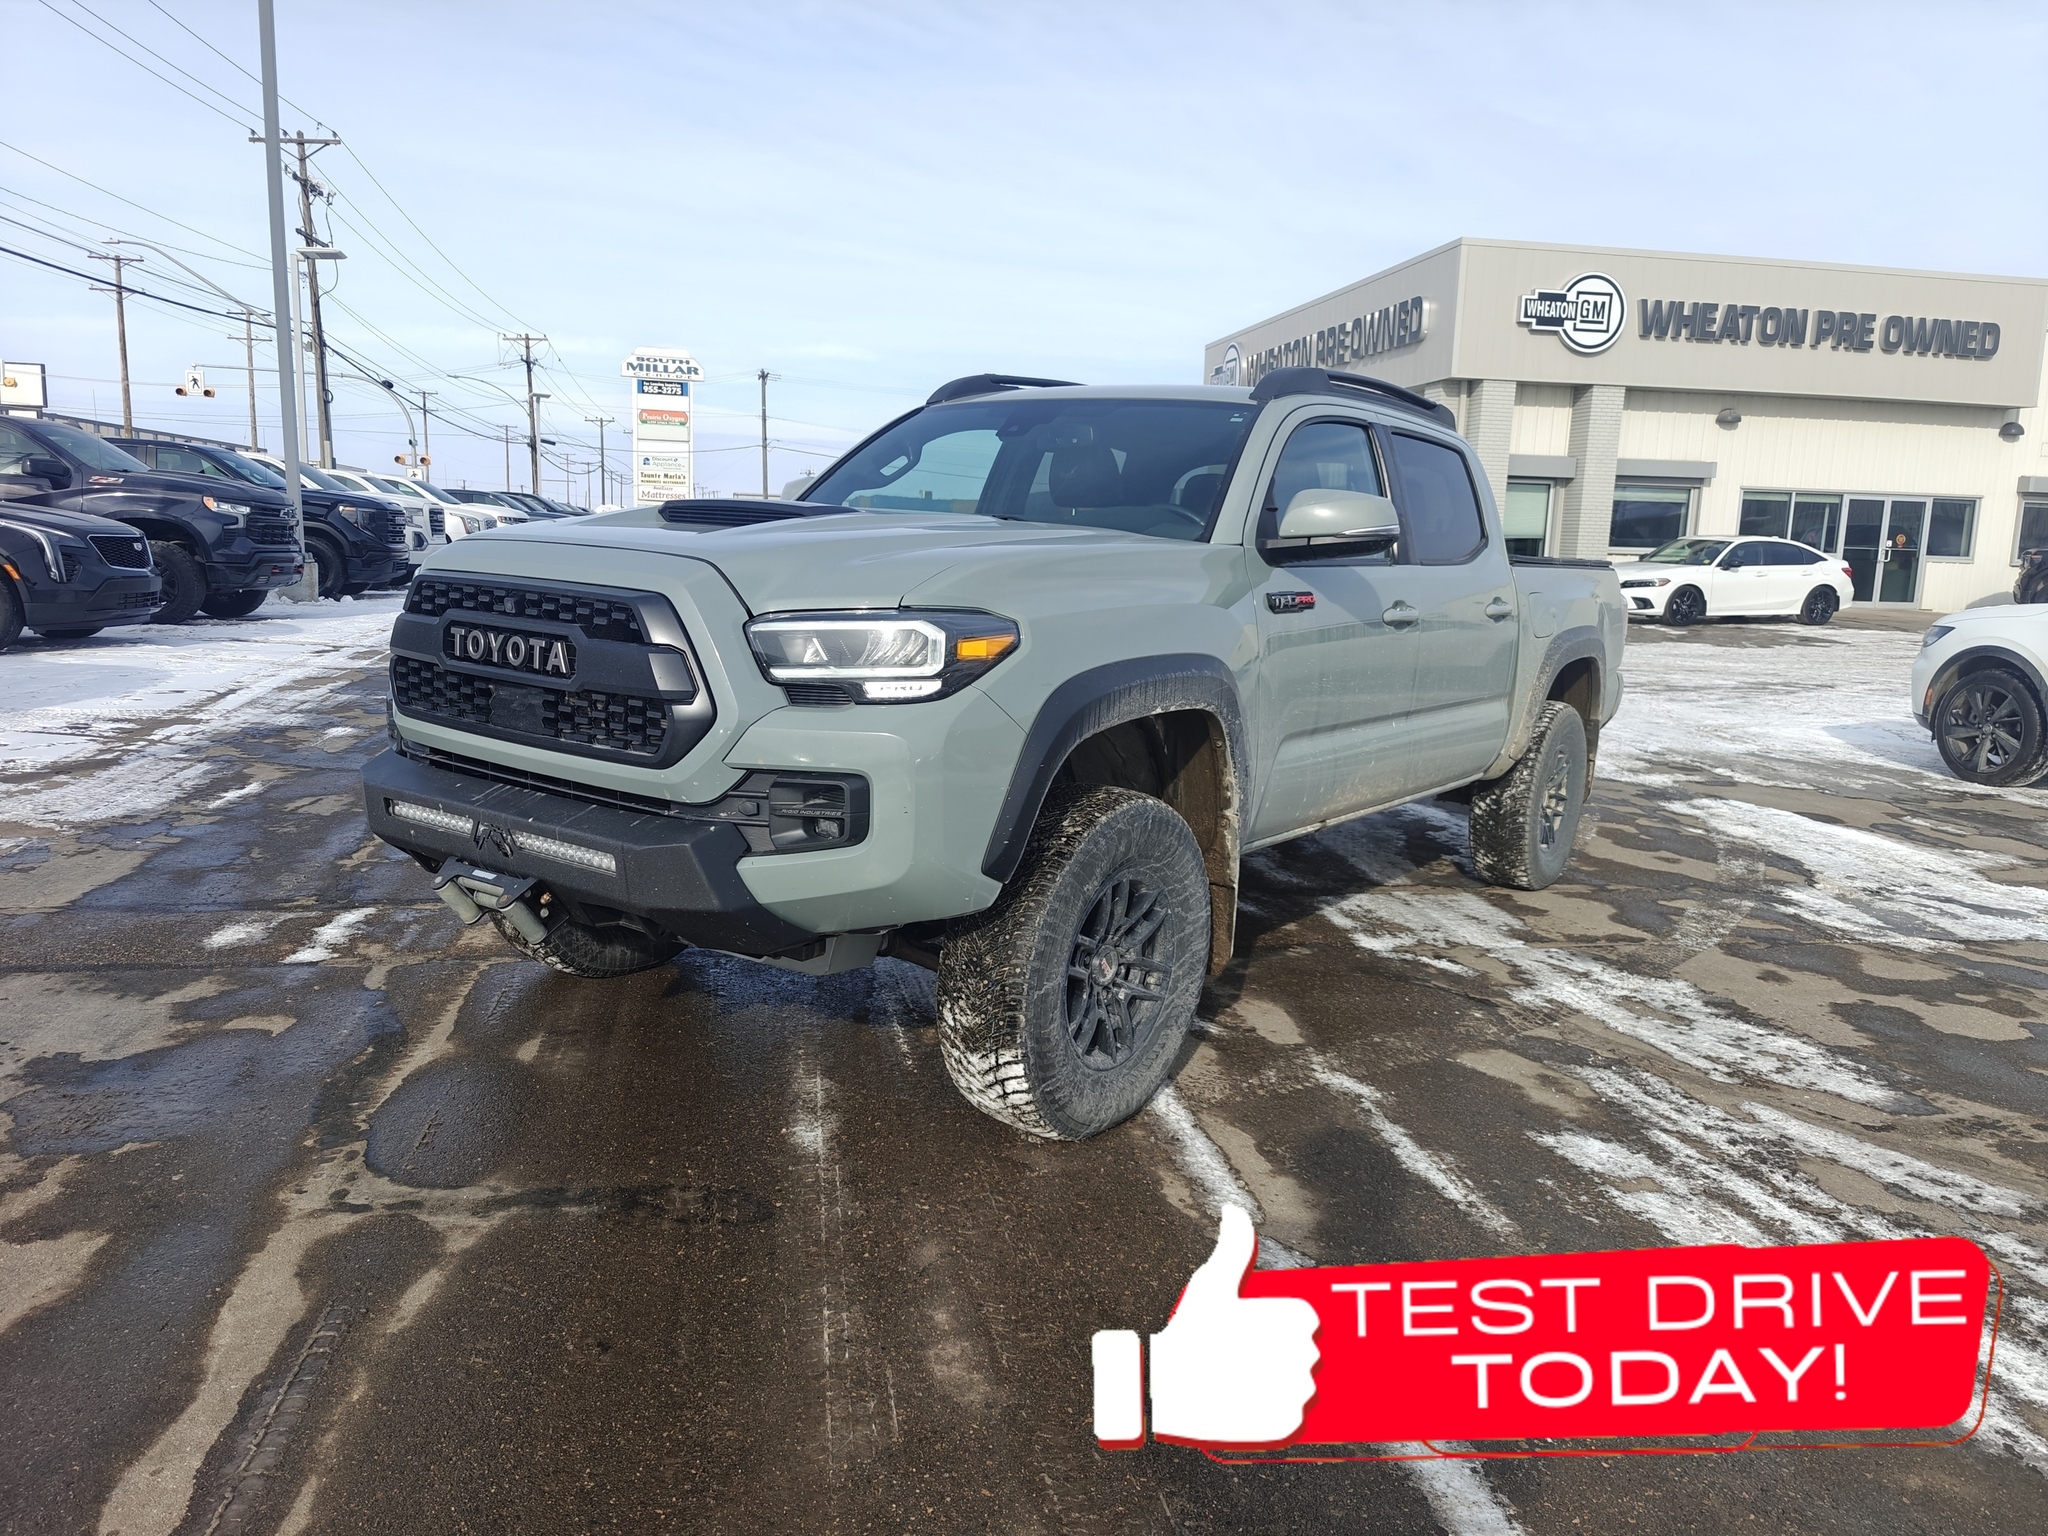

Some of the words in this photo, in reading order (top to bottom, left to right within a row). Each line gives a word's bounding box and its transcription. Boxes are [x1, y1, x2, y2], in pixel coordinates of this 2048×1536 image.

[1526, 299, 1577, 319] WHEATON
[1580, 300, 1606, 320] GM
[1637, 299, 1808, 347] WHEATON
[1811, 310, 1877, 351] PRE
[1880, 315, 2001, 360] OWNED
[1246, 333, 1314, 387] WHEATON
[1315, 322, 1348, 368] PRE
[1351, 296, 1426, 359] OWNED
[636, 356, 690, 365] SOUTH
[626, 362, 700, 376] MILLAR
[643, 385, 682, 395] 955-3275
[641, 490, 686, 499] Mattresses
[1297, 595, 1316, 604] PRO
[450, 627, 571, 674] TOYOTA
